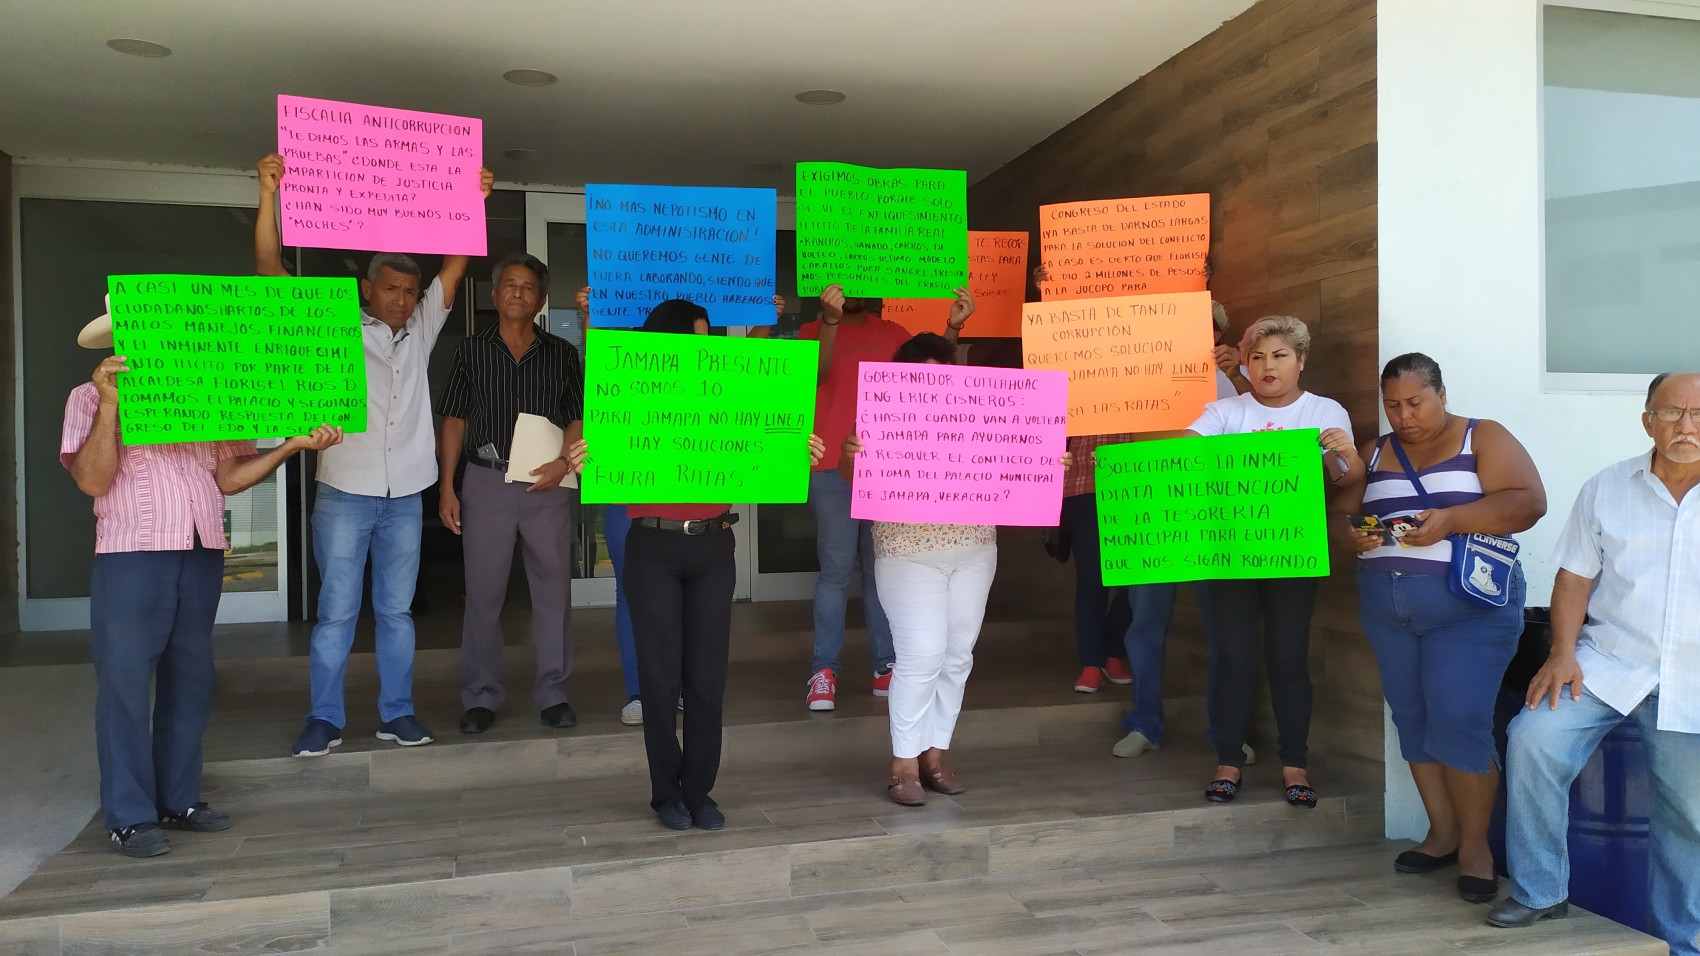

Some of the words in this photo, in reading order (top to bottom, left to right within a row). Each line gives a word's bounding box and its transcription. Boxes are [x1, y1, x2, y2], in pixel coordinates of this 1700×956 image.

[284, 105, 352, 124] FISCALIA
[364, 115, 470, 136] ANTICORRUPCION
[308, 133, 348, 145] DIMOS
[356, 137, 378, 148] LAS
[385, 138, 430, 154] ARMAS
[452, 147, 473, 157] LAS
[411, 163, 437, 172] ESTA
[373, 175, 387, 185] DE
[396, 178, 452, 190] JUSTICIA
[803, 171, 860, 184] EXIGIMOS
[868, 178, 908, 188] OBRAS
[915, 179, 945, 190] PARA
[284, 183, 328, 194] PRONTA
[351, 190, 416, 202] EXPEDITA?
[825, 189, 868, 200] PUEBLO
[878, 194, 916, 203] PORQUE
[923, 198, 952, 208] SOLO
[330, 204, 362, 215] SIDO
[368, 208, 388, 216] MUY
[395, 209, 441, 219] BUENOS
[449, 212, 470, 221] LOS
[621, 201, 645, 213] MAS
[654, 203, 727, 221] NEPOTISMO
[737, 208, 755, 221] EN
[1052, 206, 1108, 219] CONGRESO
[1117, 204, 1137, 212] DEL
[1145, 200, 1185, 210] ESTADO
[594, 222, 627, 233] ESTA
[874, 227, 913, 237] FAMILIA
[918, 228, 945, 238] REAL
[1063, 225, 1097, 236] BASTA
[1121, 219, 1165, 229] DARNOS
[1170, 216, 1208, 226] LARGAS
[1044, 243, 1066, 252] PARA
[1087, 239, 1134, 249] SOLUCION
[1140, 237, 1154, 245] DEL
[1160, 234, 1205, 243] CONFLICTO
[593, 249, 611, 261] NO
[618, 250, 687, 262] QUEREMOS
[695, 253, 735, 264] GENTE
[745, 254, 761, 266] DE
[999, 256, 1021, 265] PARA
[1059, 258, 1083, 266] CASO
[1109, 255, 1141, 263] CIERTO
[594, 272, 631, 281] FUERA
[640, 272, 705, 285] LABORANDO,
[708, 276, 750, 287] SIENDO
[755, 278, 773, 287] QUE
[979, 273, 997, 282] LEY
[1096, 268, 1144, 278] MILLONES
[115, 282, 126, 295] A
[137, 282, 177, 295] CASI
[191, 282, 213, 296] UN
[221, 284, 257, 297] MES
[265, 286, 284, 299] DE
[292, 287, 323, 300] QUE
[330, 287, 354, 299] LOS
[918, 281, 950, 290] ERARIO
[1076, 283, 1114, 294] JUCOPO
[1122, 283, 1147, 291] PARA
[593, 289, 607, 299] EN
[615, 289, 668, 300] NUESTRO
[676, 291, 716, 303] PUEBLO
[723, 295, 771, 305] HABEMOS
[280, 306, 297, 317] DE
[307, 306, 336, 317] LOS
[592, 308, 629, 316] GENTE
[1027, 313, 1042, 325] YA
[1050, 307, 1096, 323] BASTA
[1107, 307, 1122, 318] DE
[1130, 303, 1176, 316] TANTA
[115, 319, 172, 330] MALOS
[185, 321, 260, 335] MANEJOS
[269, 325, 361, 338] FINANCIEROS
[1053, 325, 1131, 341] CORRUPCION
[133, 340, 147, 349] EL
[161, 340, 242, 353] INMINENTE
[1028, 348, 1102, 364] QUEREMOS
[1110, 341, 1172, 356] SOLUCION
[235, 362, 258, 373] POR
[265, 363, 303, 374] PARTE
[316, 363, 332, 374] DE
[340, 363, 354, 374] LA
[605, 346, 678, 373] JAMAPA
[696, 349, 792, 376] PRESENTE
[1069, 366, 1118, 381] JAMAPA
[1125, 366, 1139, 376] NO
[1145, 363, 1163, 374] HAY
[1172, 363, 1208, 374] LINEA
[123, 376, 203, 387] ALCALDESA
[214, 379, 289, 391] FLORISEL
[297, 380, 336, 392] RIOS
[596, 383, 620, 396] NO
[630, 380, 685, 396] SOMOS
[700, 380, 722, 395] 10
[864, 371, 954, 386] GOBERNADOR
[965, 376, 1038, 390] CUITLAHUAC
[124, 392, 198, 405] TOMAMOS
[229, 395, 280, 408] PALACIO
[900, 392, 938, 403] ERICK
[124, 408, 210, 420] ESPERANDO
[220, 410, 294, 422] RESPUESTA
[304, 411, 326, 422] DEL
[1094, 402, 1120, 414] LAS
[590, 409, 631, 425] PARA
[642, 412, 700, 426] JAMAPA
[709, 411, 728, 425] NO
[735, 412, 761, 426] HAY
[764, 413, 804, 427] LINEA
[926, 414, 975, 423] CUANDO
[984, 416, 1006, 424] VAN
[1025, 416, 1066, 425] VOLTEAR
[126, 424, 172, 434] GRESO
[182, 422, 206, 432] DEL
[219, 424, 245, 432] EDO
[630, 436, 660, 450] HAY
[673, 437, 763, 453] SOLUCIONES
[878, 431, 928, 440] JAMAPA
[937, 432, 964, 442] PARA
[972, 432, 1042, 444] AYUDARNOS
[876, 450, 939, 460] RESOLVER
[949, 452, 963, 463] EL
[972, 455, 1032, 464] CONFLICTO
[1098, 456, 1205, 478] SOLICITAMOS
[1217, 454, 1234, 469] LA
[880, 469, 910, 479] TOMA
[918, 470, 938, 480] DEL
[945, 471, 992, 481] PALACIO
[1000, 474, 1054, 483] MUNICIPAL
[1101, 485, 1152, 502] DIATA
[1168, 476, 1299, 498] INTERVENCION
[1103, 515, 1119, 525] DE
[1135, 512, 1151, 525] LA
[1163, 504, 1269, 522] TESORERIA
[1104, 530, 1190, 547] MUNICIPAL
[1200, 529, 1236, 542] PARA
[1245, 526, 1304, 541] EVITAR
[1474, 533, 1518, 553] CONVERSE
[1105, 558, 1129, 570] QUE
[1143, 556, 1173, 568] NOS
[1184, 552, 1231, 567] SIGAN
[1242, 555, 1317, 570] ROBANDO
